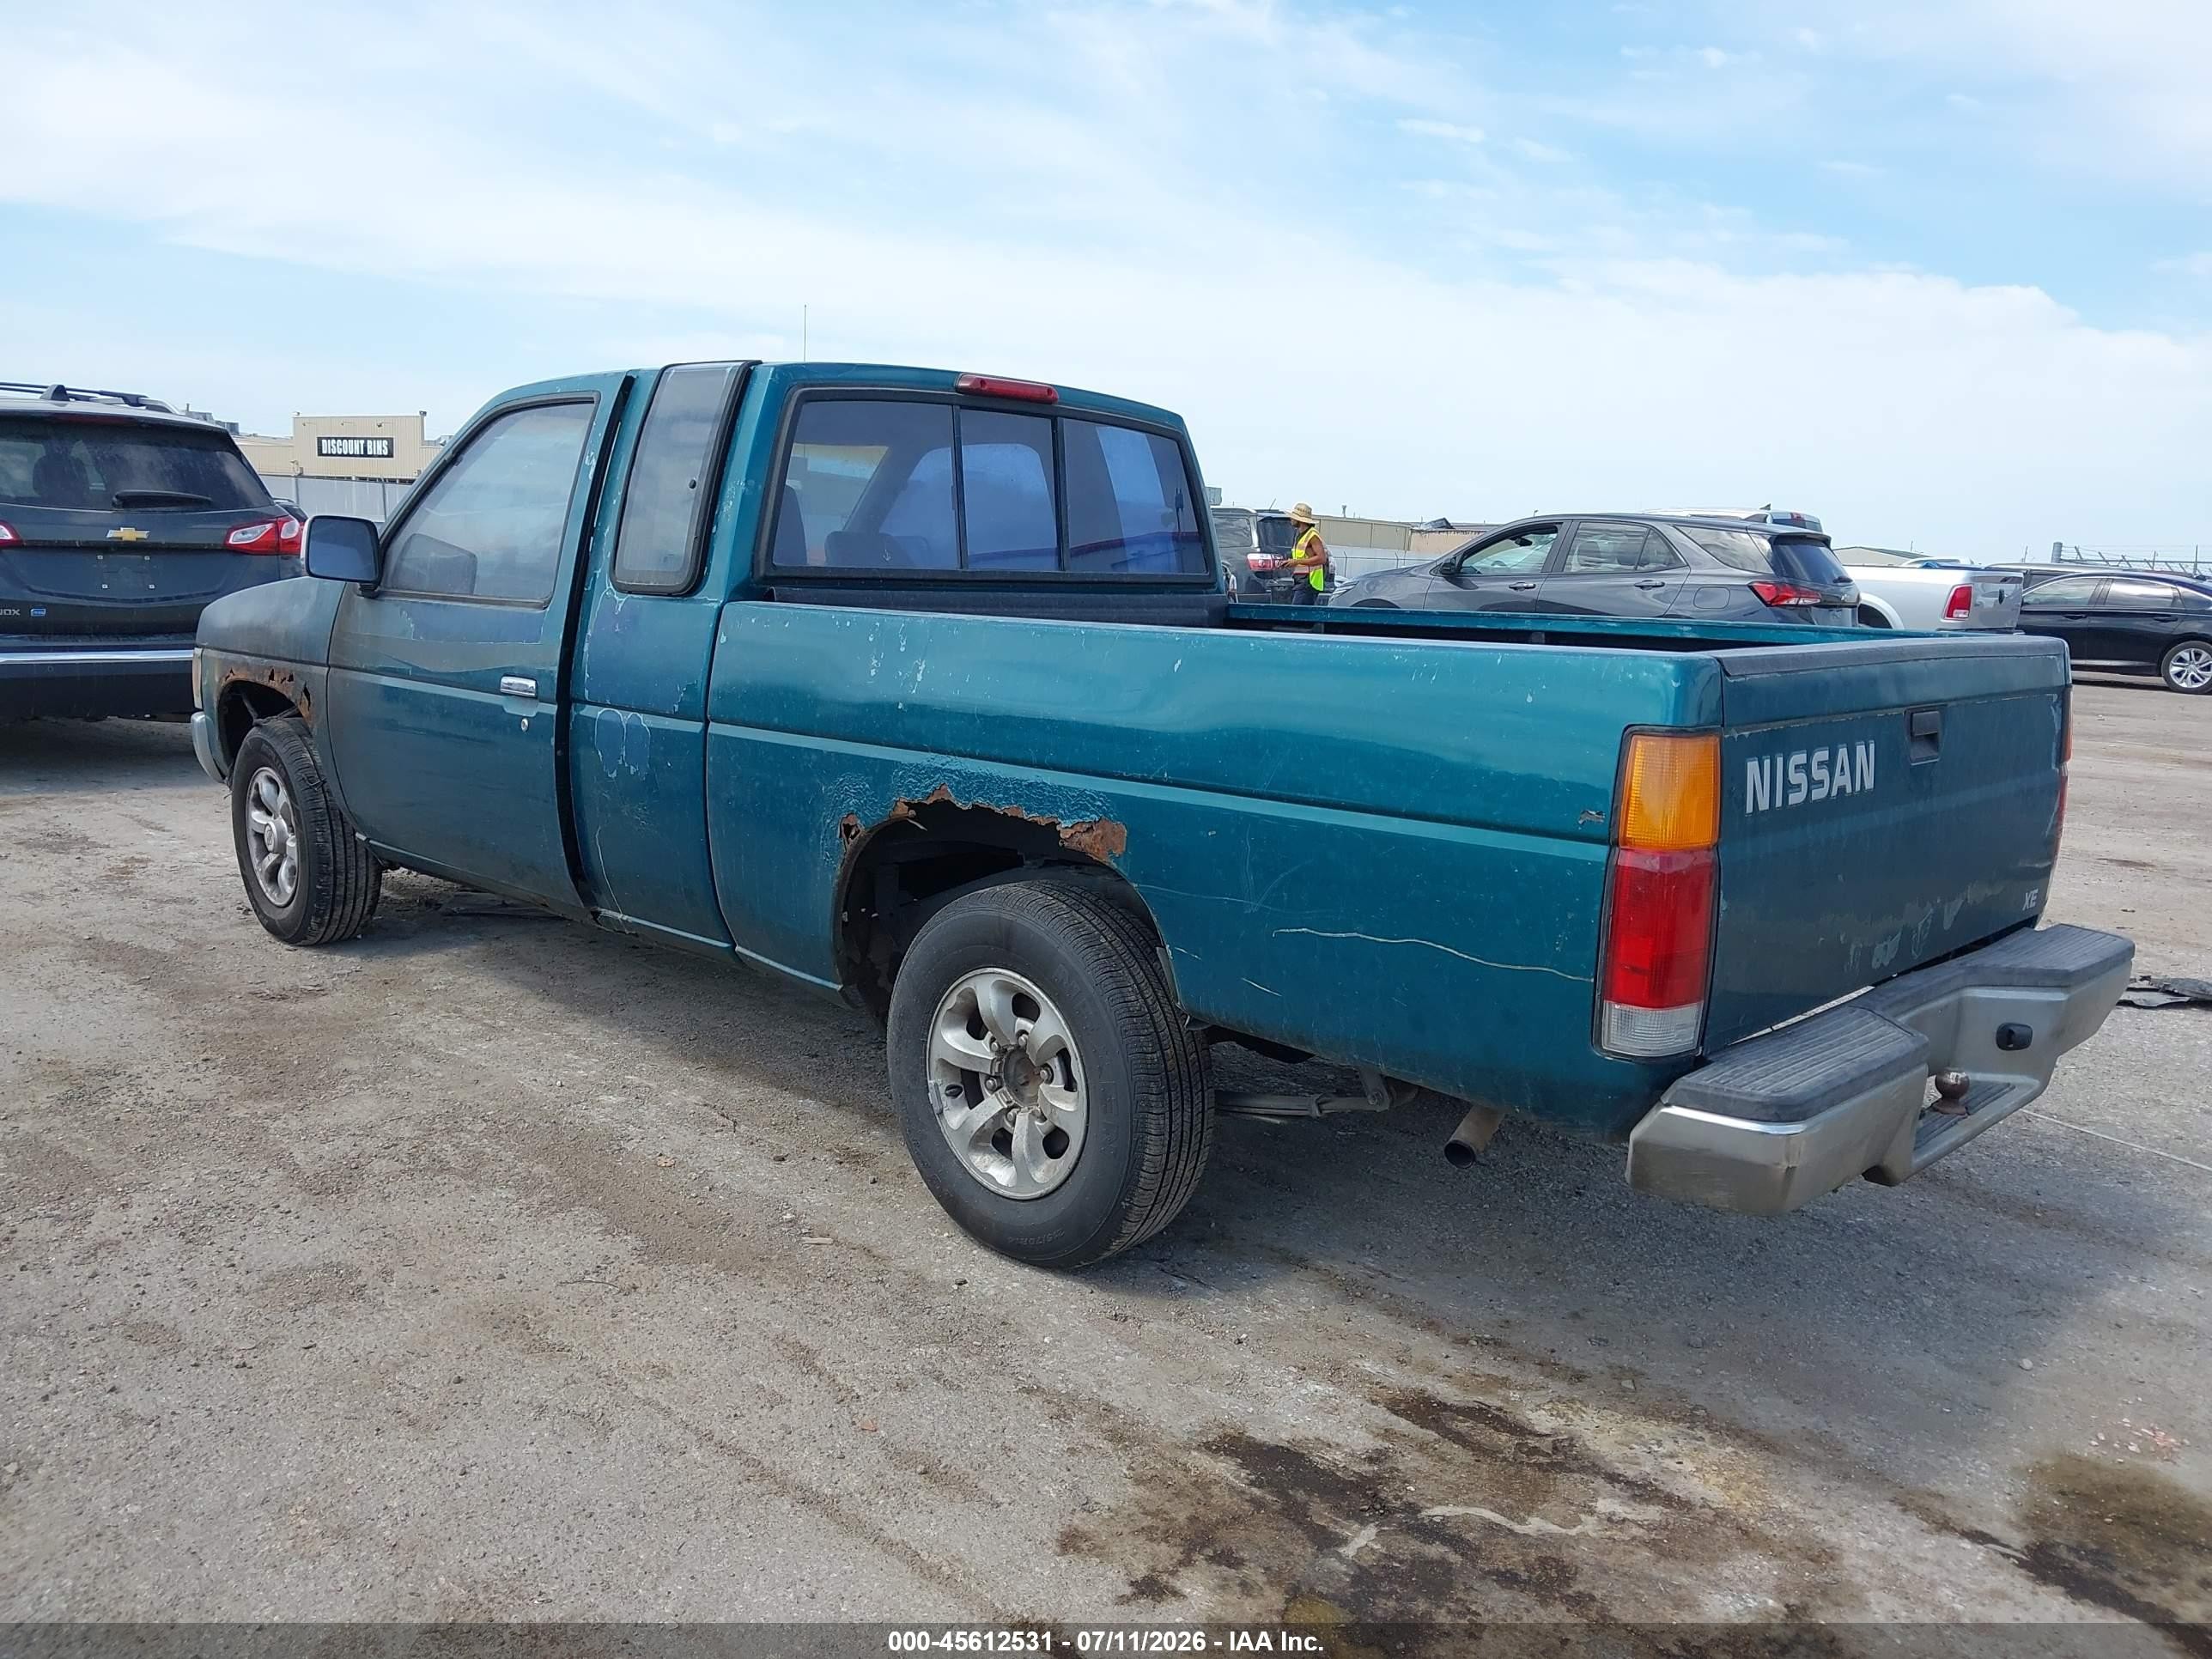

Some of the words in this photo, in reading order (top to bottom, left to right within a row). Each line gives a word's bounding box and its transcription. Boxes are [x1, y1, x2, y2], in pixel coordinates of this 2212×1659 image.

[321, 439, 365, 455] DISCOUNT
[367, 440, 388, 456] BINS
[1745, 739, 1876, 815] NISSAN
[2022, 888, 2039, 911] XE
